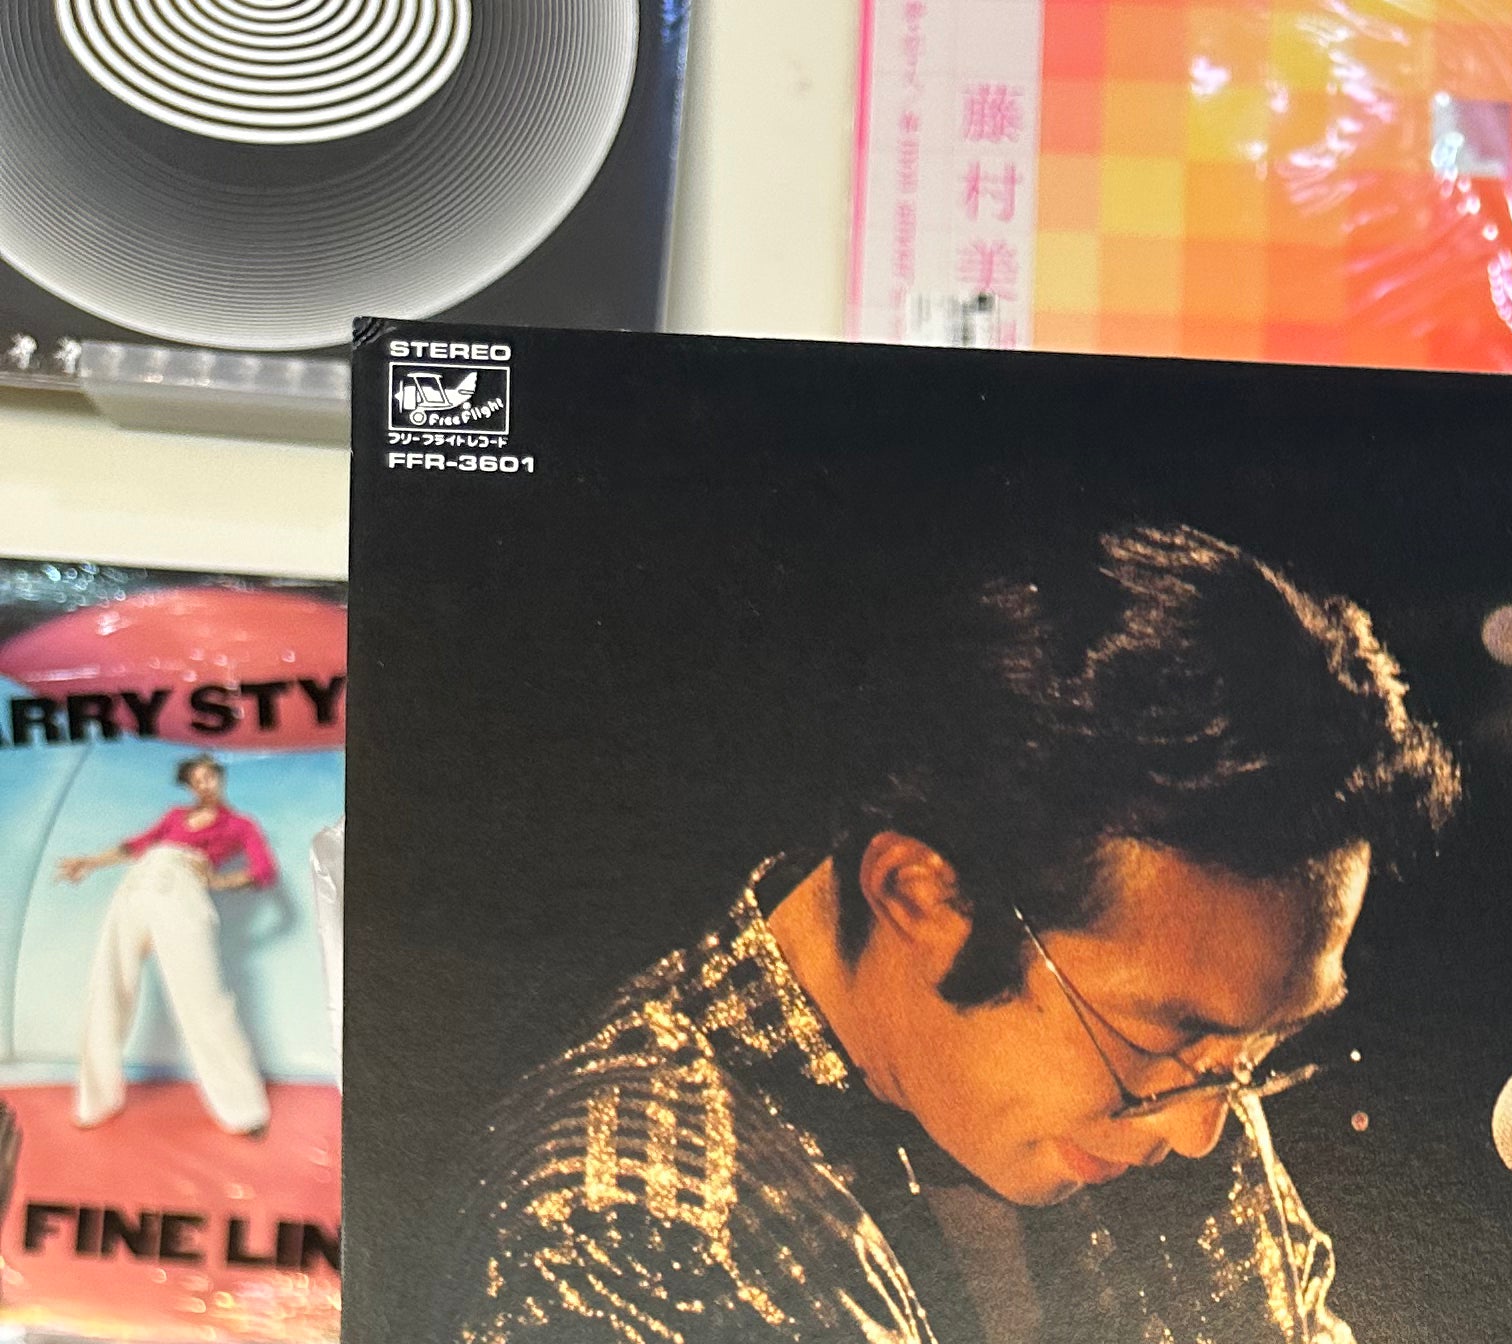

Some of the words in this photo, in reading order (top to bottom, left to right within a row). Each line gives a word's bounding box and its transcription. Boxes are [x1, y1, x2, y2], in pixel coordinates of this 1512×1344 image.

[389, 340, 511, 361] STEREO
[388, 453, 535, 473] FFR-3601
[0, 688, 173, 748] RRY
[25, 1203, 206, 1262] FINE
